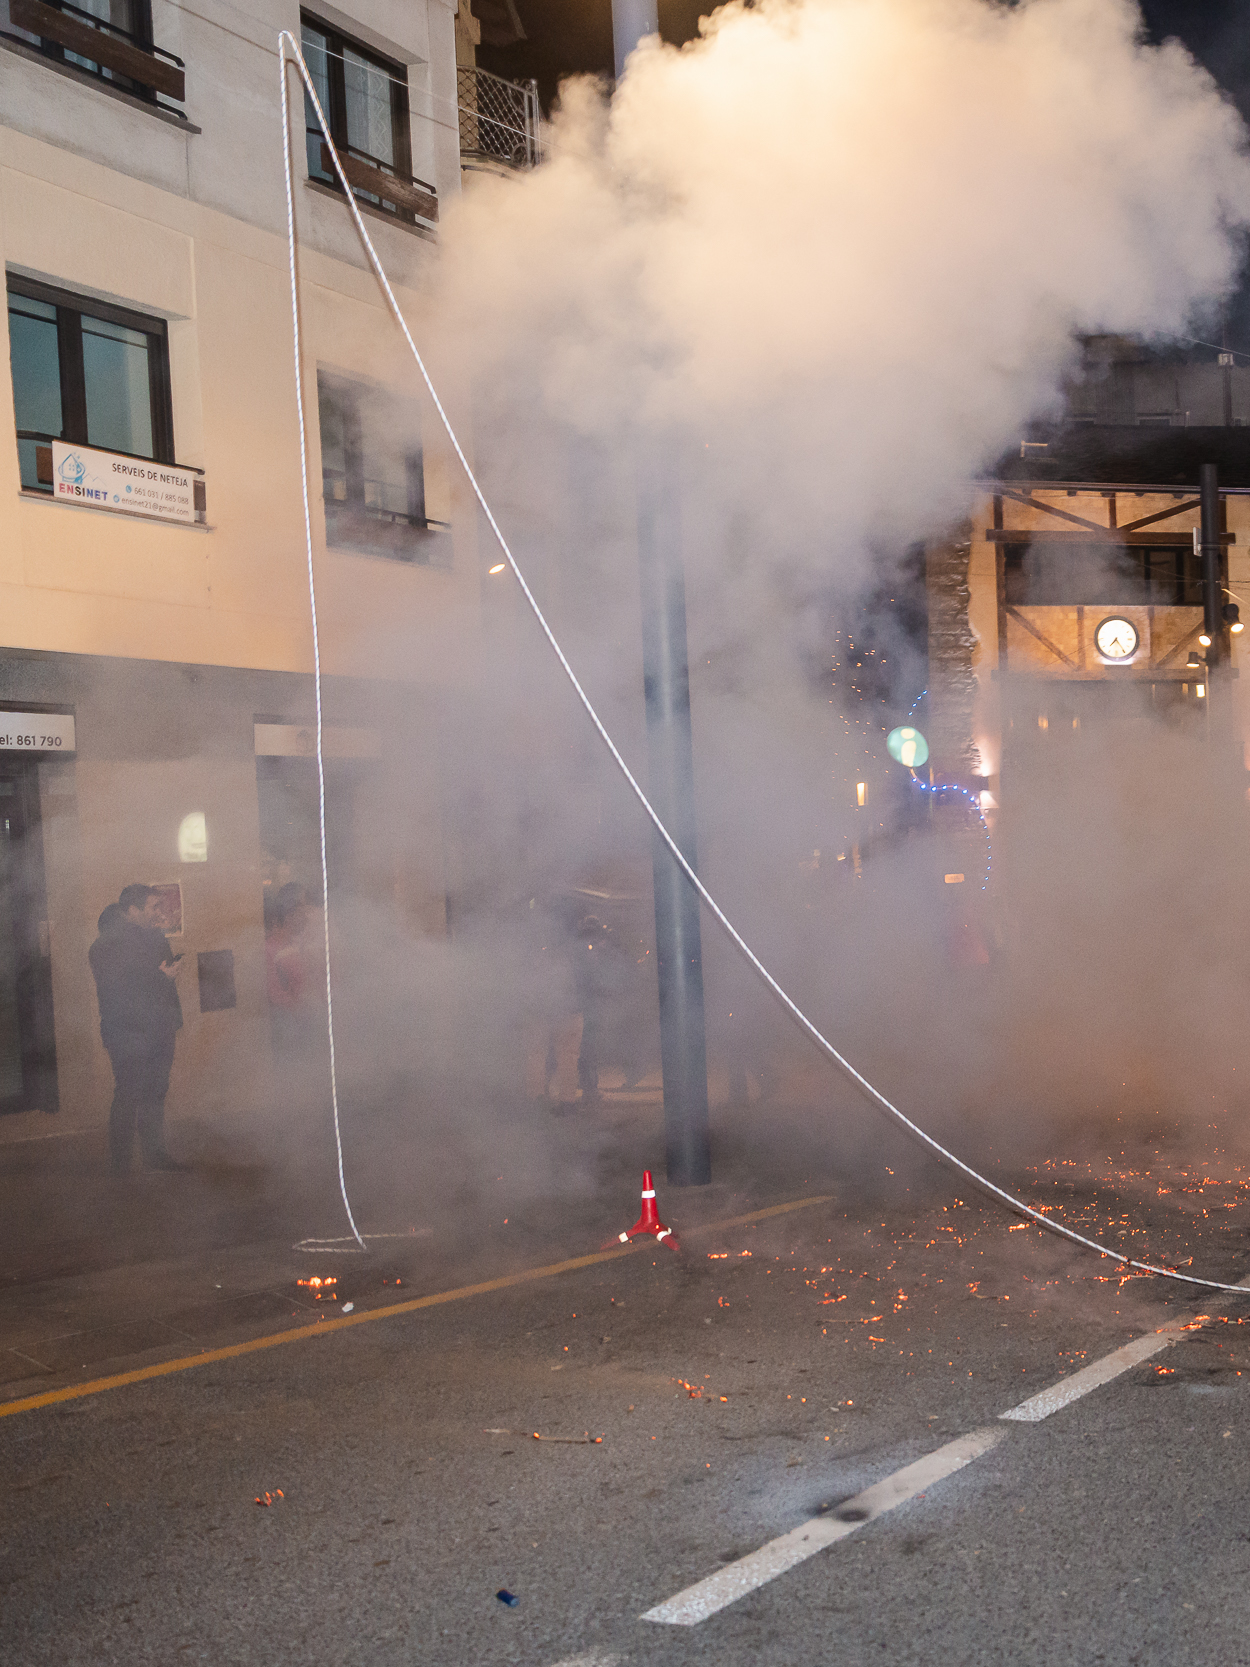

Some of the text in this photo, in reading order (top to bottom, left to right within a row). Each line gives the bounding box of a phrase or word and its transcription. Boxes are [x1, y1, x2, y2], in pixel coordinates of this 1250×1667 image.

[112, 463, 188, 488] SERVEIS DE NETEJA
[59, 482, 108, 501] ENSINET
[134, 487, 146, 496] 661
[121, 497, 189, 516] ensinet21@gmail.com
[16, 735, 36, 746] 861
[40, 736, 62, 747] 790
